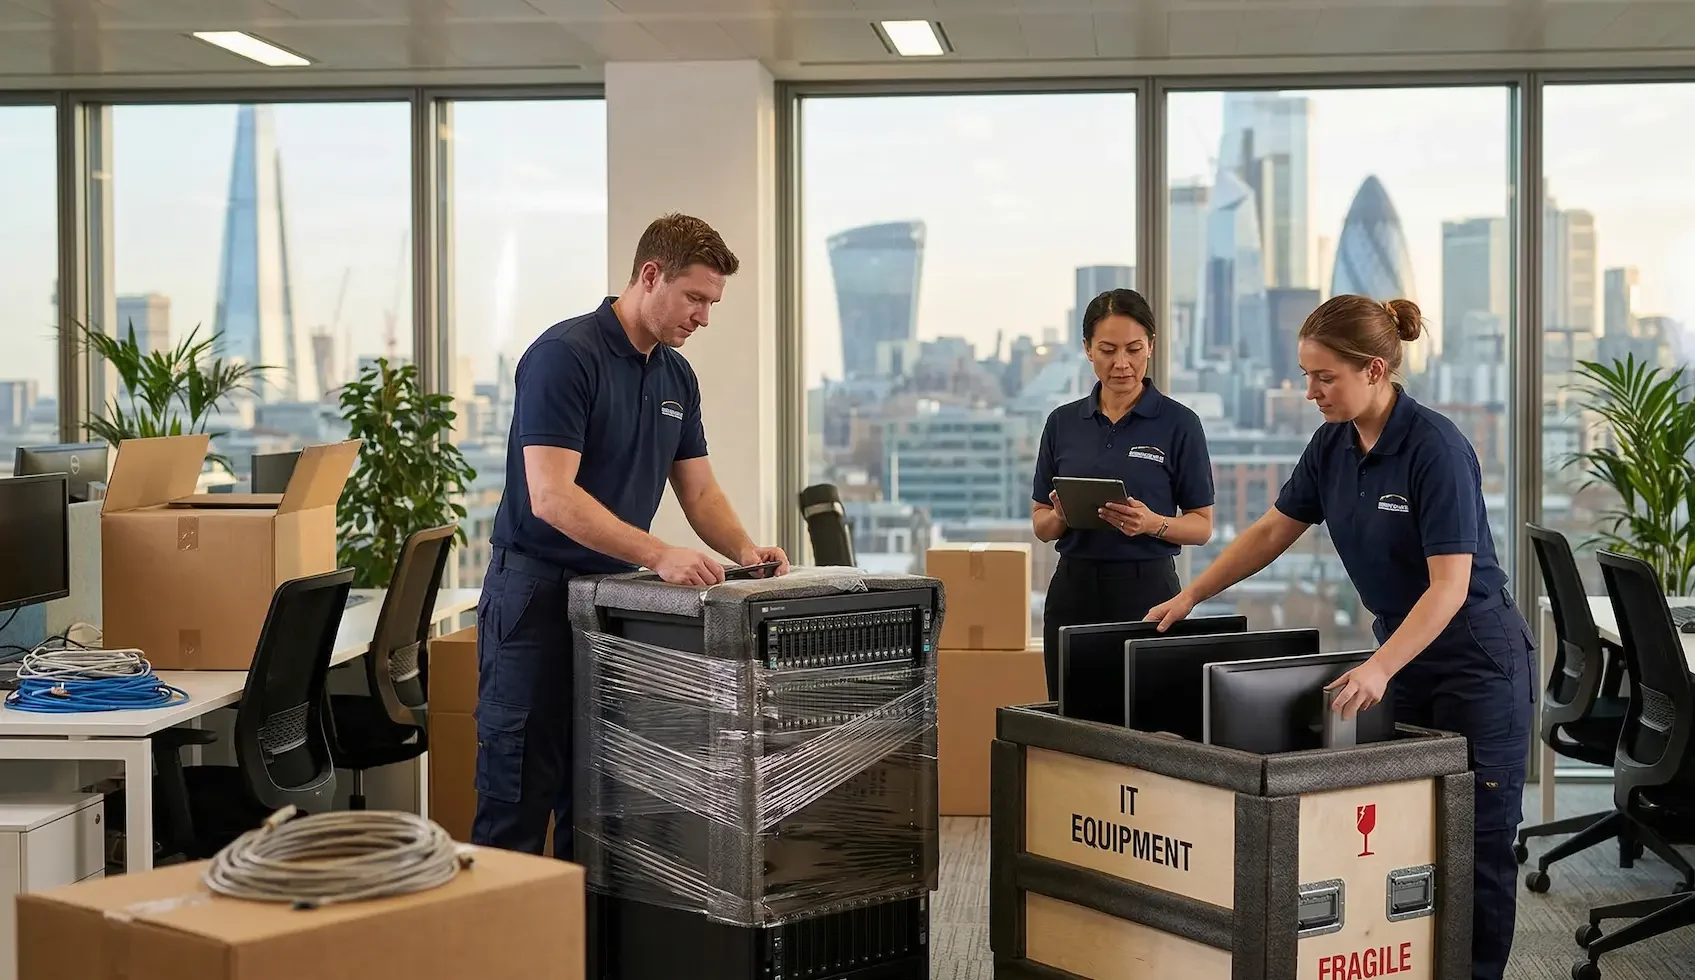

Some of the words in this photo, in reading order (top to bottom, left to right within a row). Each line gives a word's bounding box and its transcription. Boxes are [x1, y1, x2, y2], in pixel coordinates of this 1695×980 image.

[1120, 784, 1138, 816] IT
[1072, 813, 1193, 871] EQUIPMENT
[1318, 942, 1411, 980] FRAGILE
